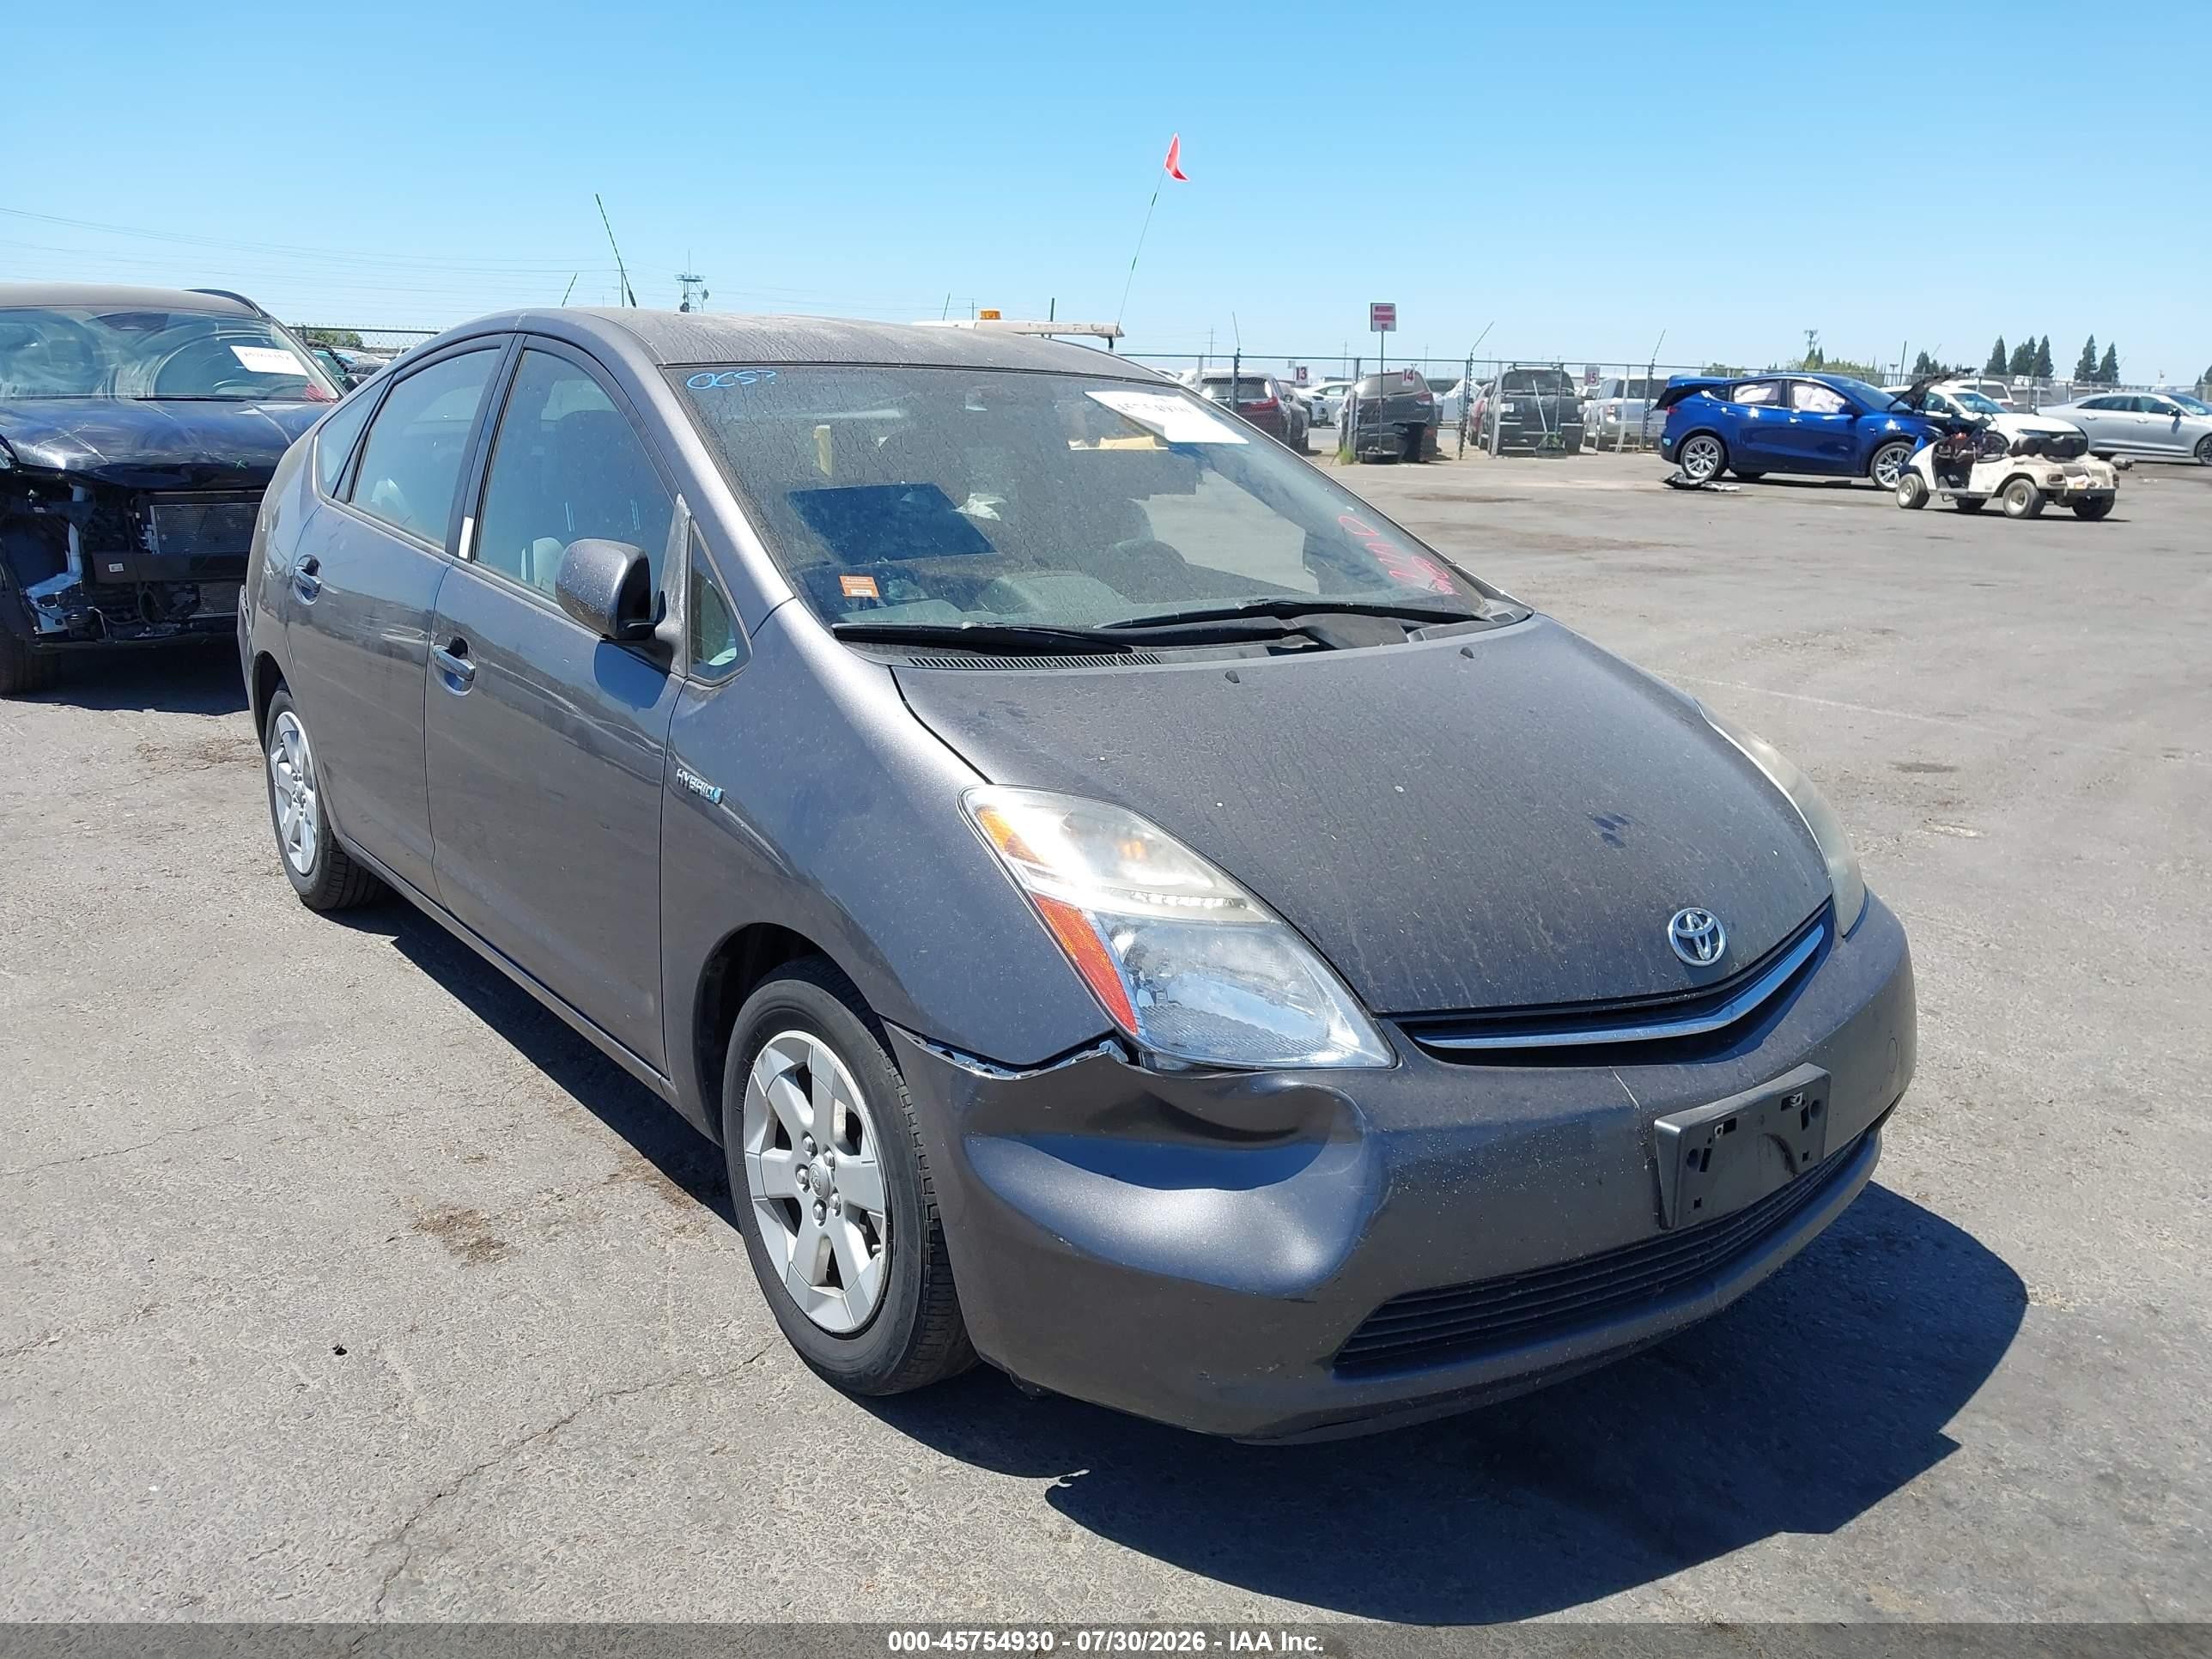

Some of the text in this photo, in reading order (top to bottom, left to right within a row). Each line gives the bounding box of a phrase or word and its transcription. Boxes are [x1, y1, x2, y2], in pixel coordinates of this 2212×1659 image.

[1296, 367, 1308, 380] 13
[1403, 368, 1414, 381] 14
[1587, 372, 1597, 384] 15
[677, 769, 714, 799] HYBRID
